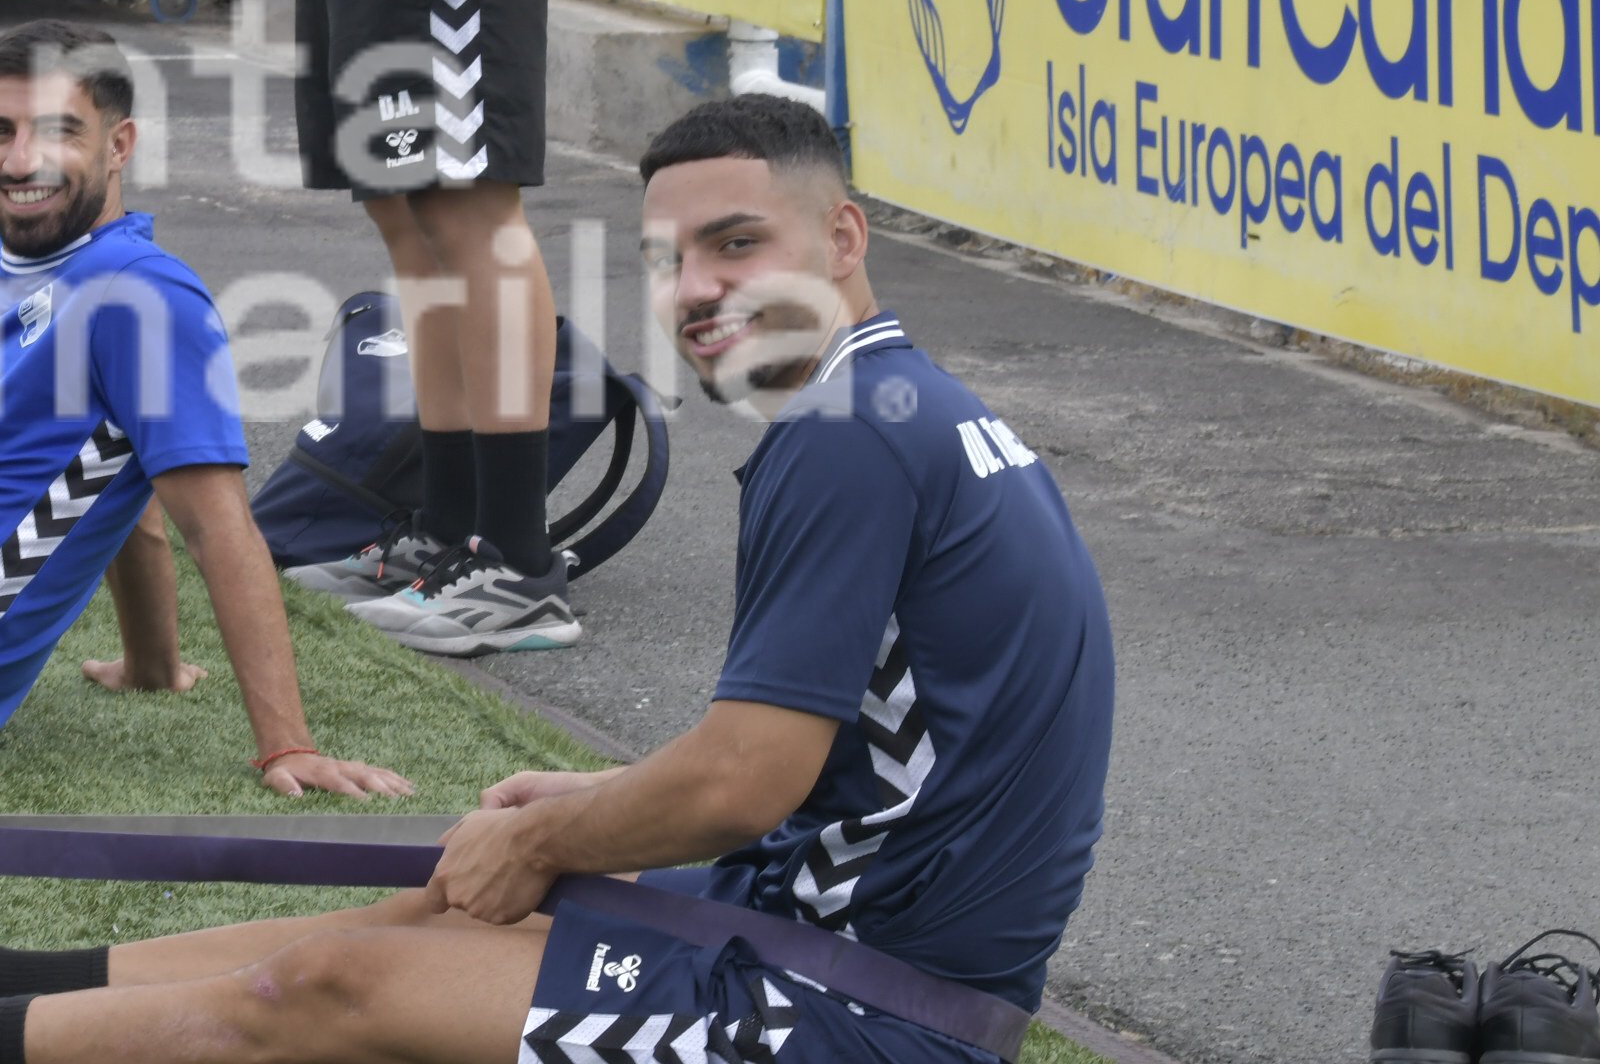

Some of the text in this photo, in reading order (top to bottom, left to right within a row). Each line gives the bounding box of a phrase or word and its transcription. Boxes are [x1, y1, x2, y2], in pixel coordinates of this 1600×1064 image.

[1047, 62, 1600, 333] Isla Europea del Dep
